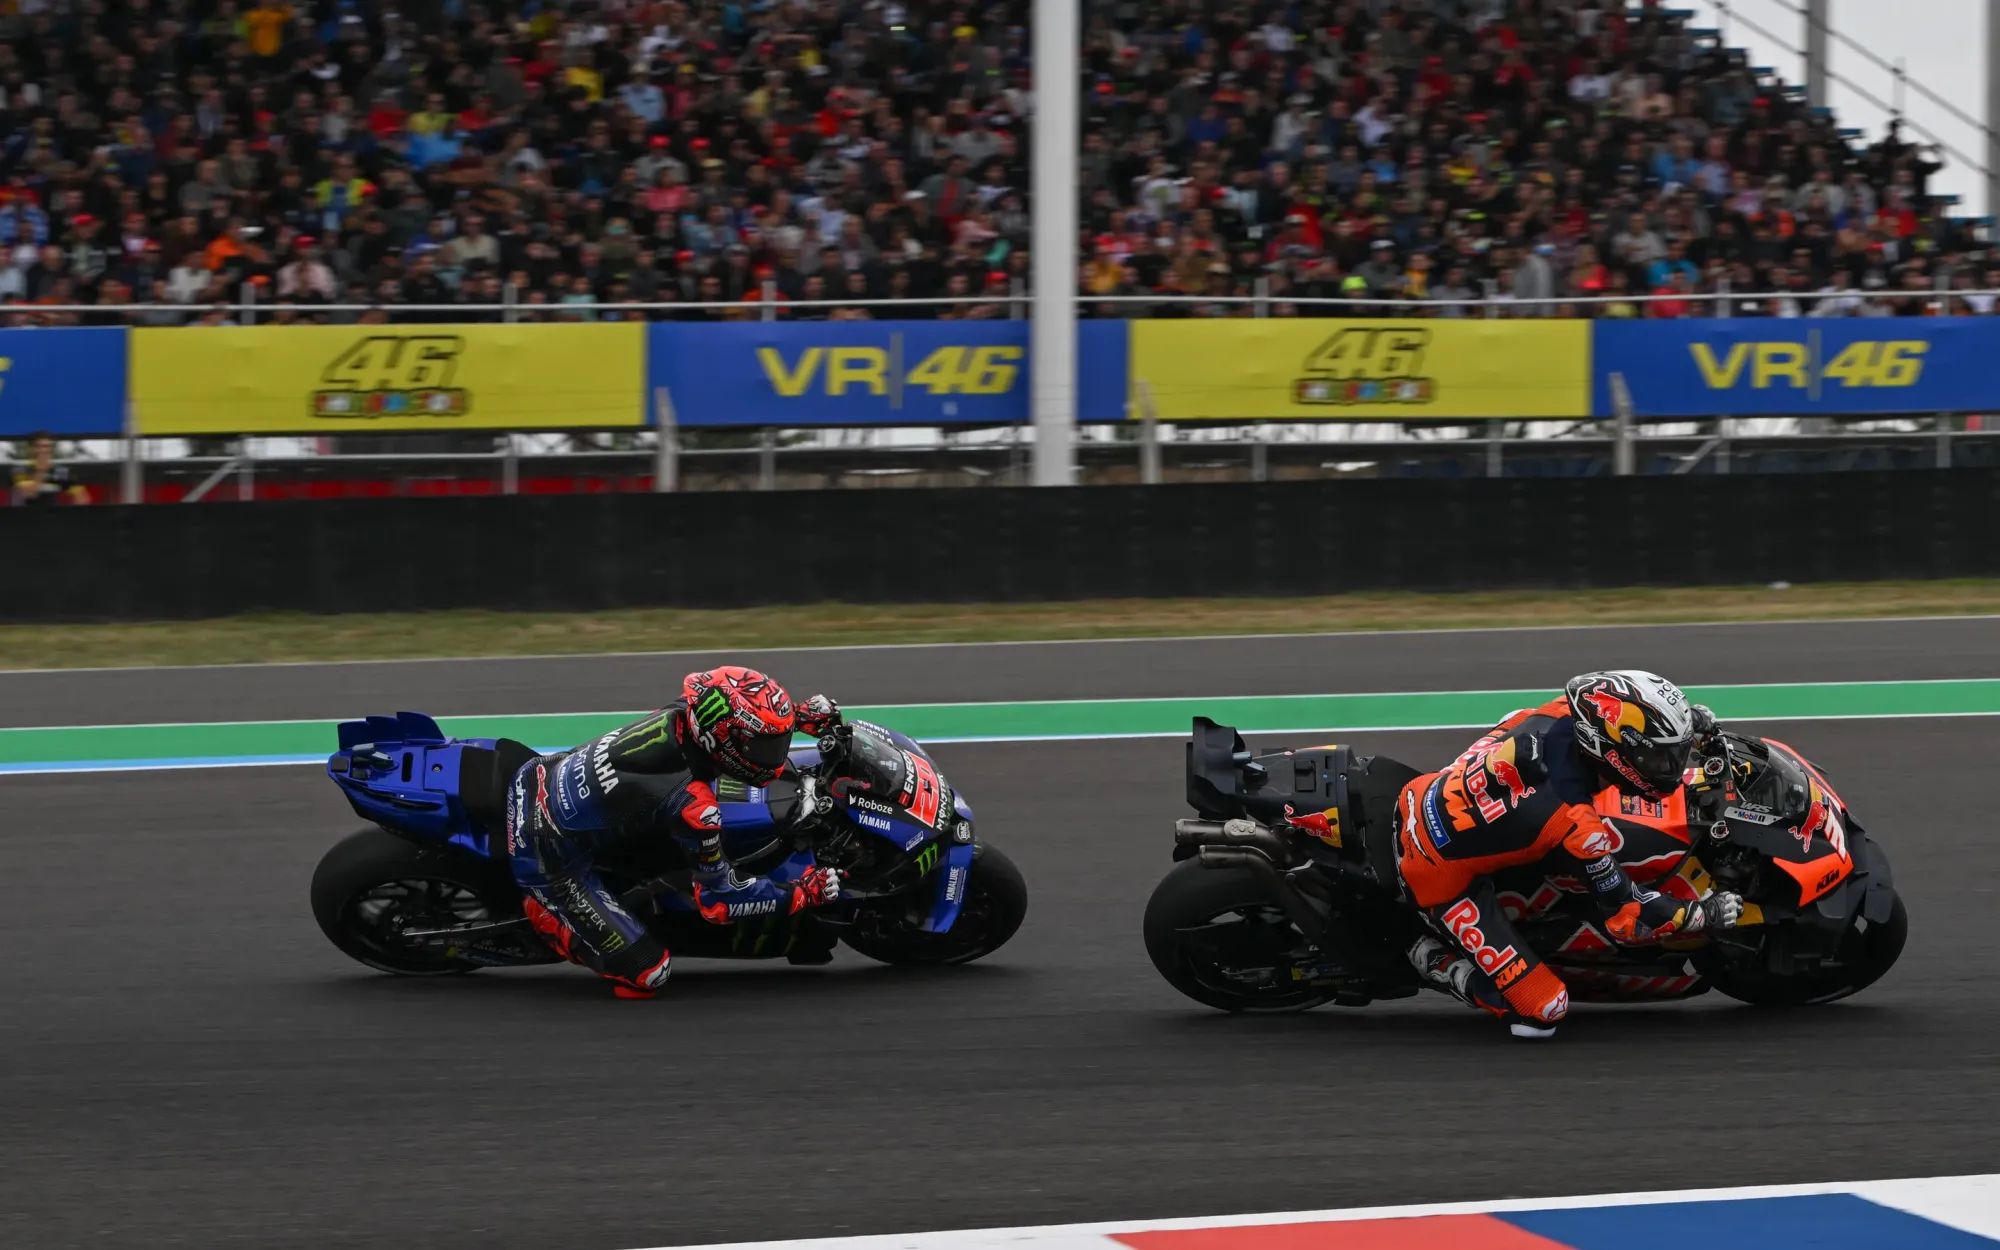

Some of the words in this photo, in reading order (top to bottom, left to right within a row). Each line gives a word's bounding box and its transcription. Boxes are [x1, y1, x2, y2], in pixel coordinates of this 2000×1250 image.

[320, 335, 465, 389] 46
[757, 346, 888, 396] VR
[907, 345, 1023, 394] 46
[1301, 327, 1432, 378] 46
[1688, 341, 1808, 389] VR
[1823, 340, 1929, 387] 46
[593, 728, 623, 794] YAMAHA
[1604, 749, 1632, 779] Red
[558, 765, 571, 811] MICHELIN
[858, 796, 893, 815] Roboze
[1441, 763, 1477, 833] KTM
[1466, 769, 1508, 824] Bull
[858, 814, 891, 831] YAMAHA
[1426, 790, 1443, 838] MICHELIN
[1738, 811, 1757, 820] Mobil
[565, 878, 607, 931] MONSTER
[945, 865, 960, 901] YAMALUBE
[1816, 869, 1840, 893] KTM
[728, 899, 777, 918] YAMAHA
[1440, 896, 1518, 977] Red
[1494, 957, 1528, 989] KTM
